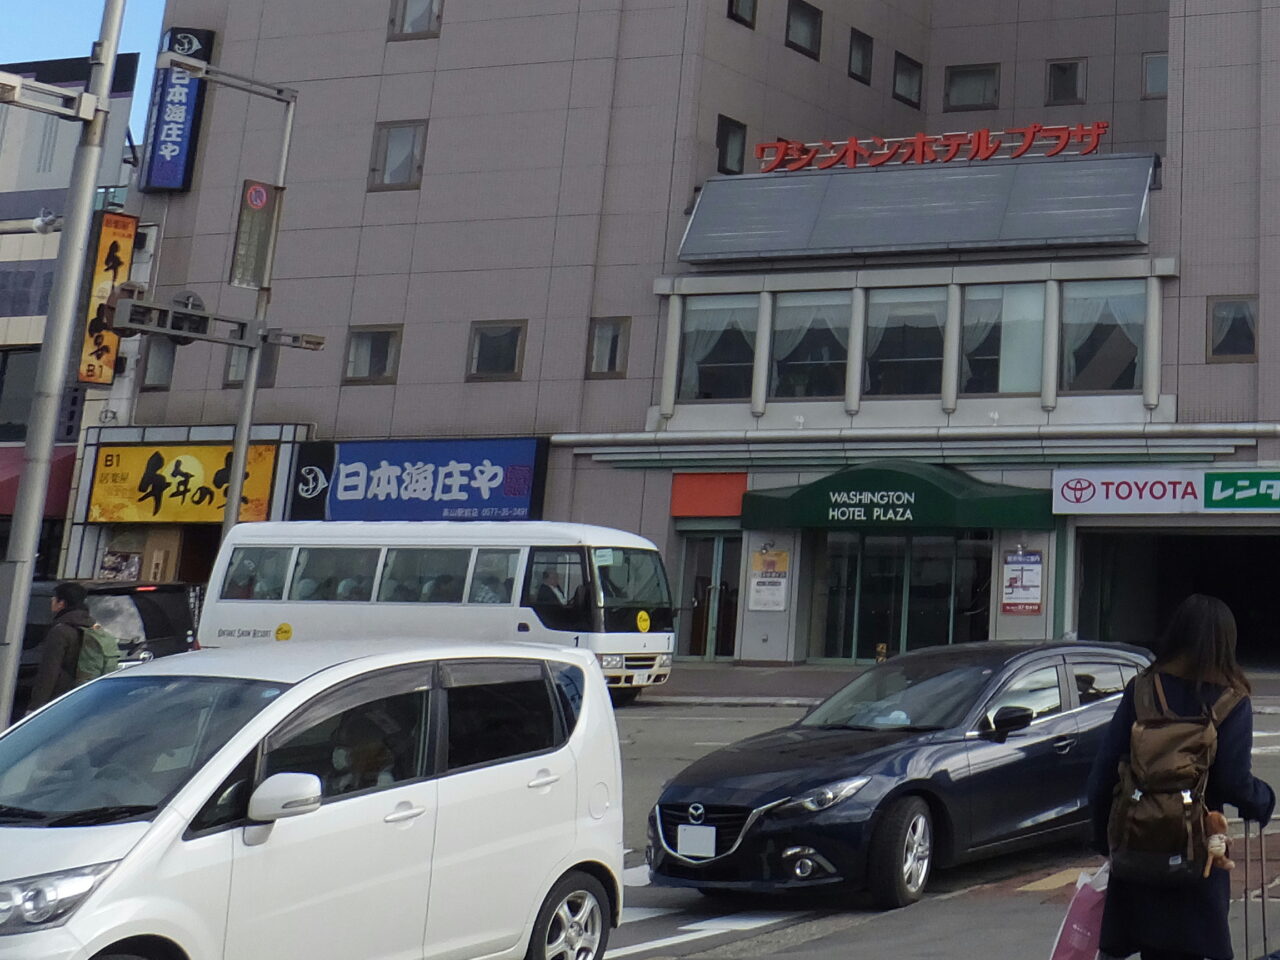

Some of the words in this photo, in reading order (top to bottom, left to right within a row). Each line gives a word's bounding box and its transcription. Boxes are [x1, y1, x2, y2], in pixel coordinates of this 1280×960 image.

[104, 453, 121, 467] B1
[336, 459, 504, 502] 日本海庄や
[1101, 480, 1198, 500] TOYOTA
[829, 491, 915, 504] WASHINGTON
[828, 507, 867, 520] HOTEL
[873, 507, 913, 520] PLAZA
